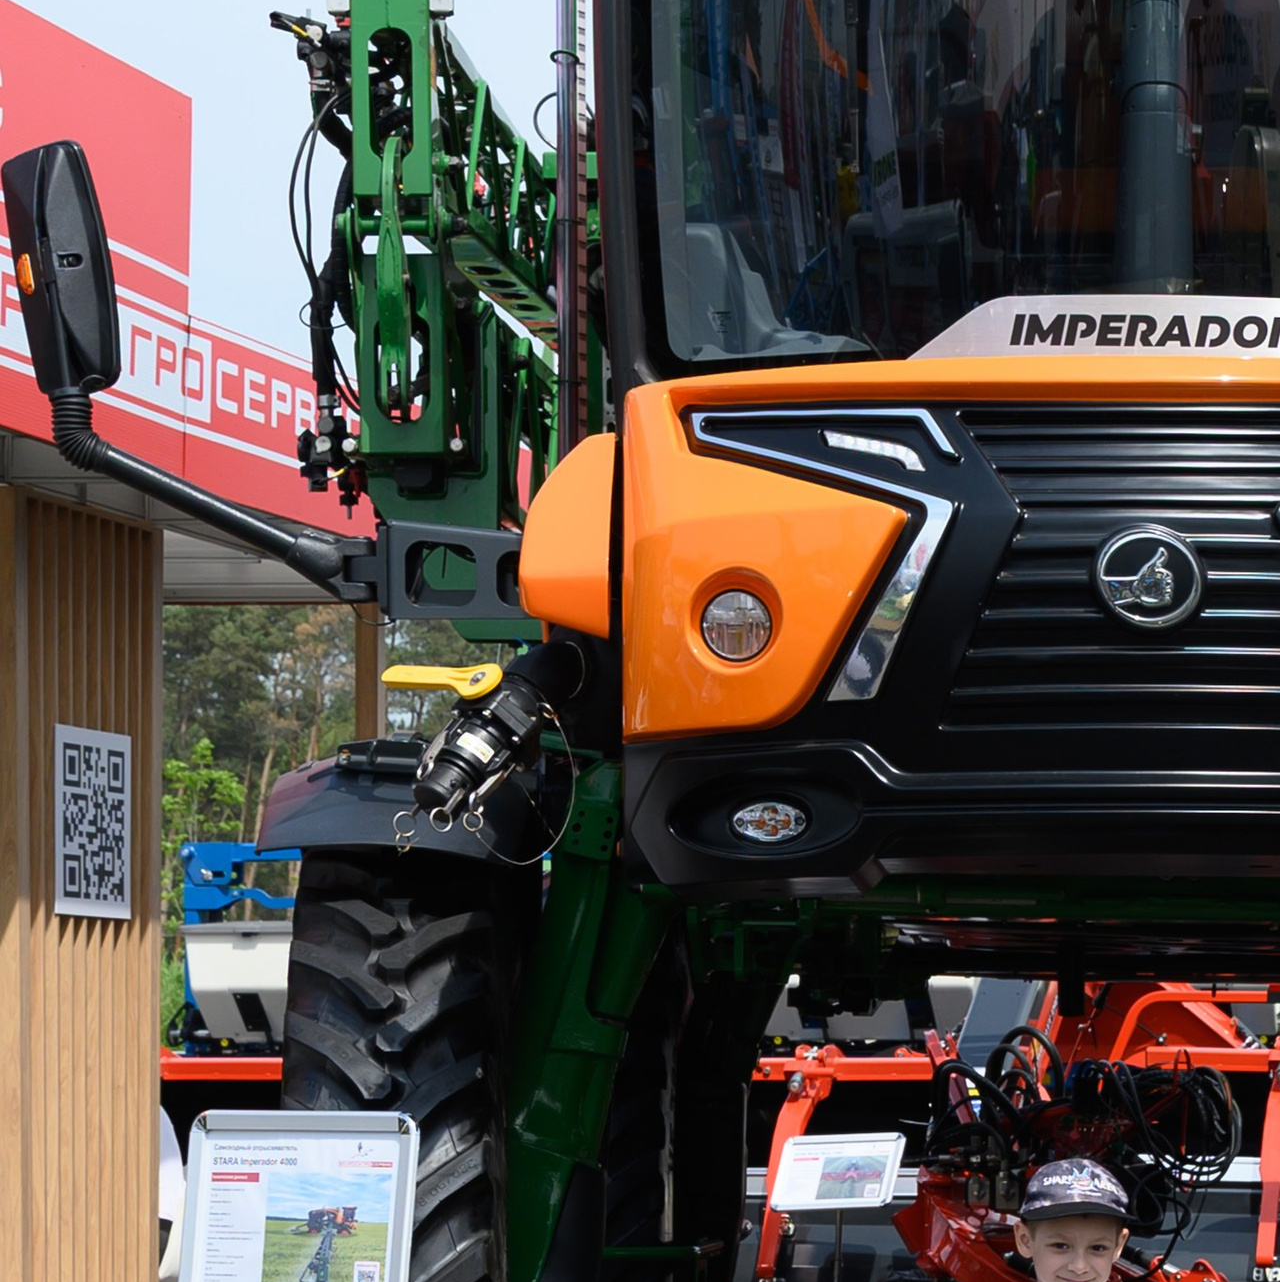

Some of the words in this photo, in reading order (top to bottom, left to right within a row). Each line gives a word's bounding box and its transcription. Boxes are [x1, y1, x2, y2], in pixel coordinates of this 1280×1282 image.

[213, 1157, 239, 1166] STARA
[240, 1157, 278, 1167] Imperador
[280, 1157, 298, 1166] 4000
